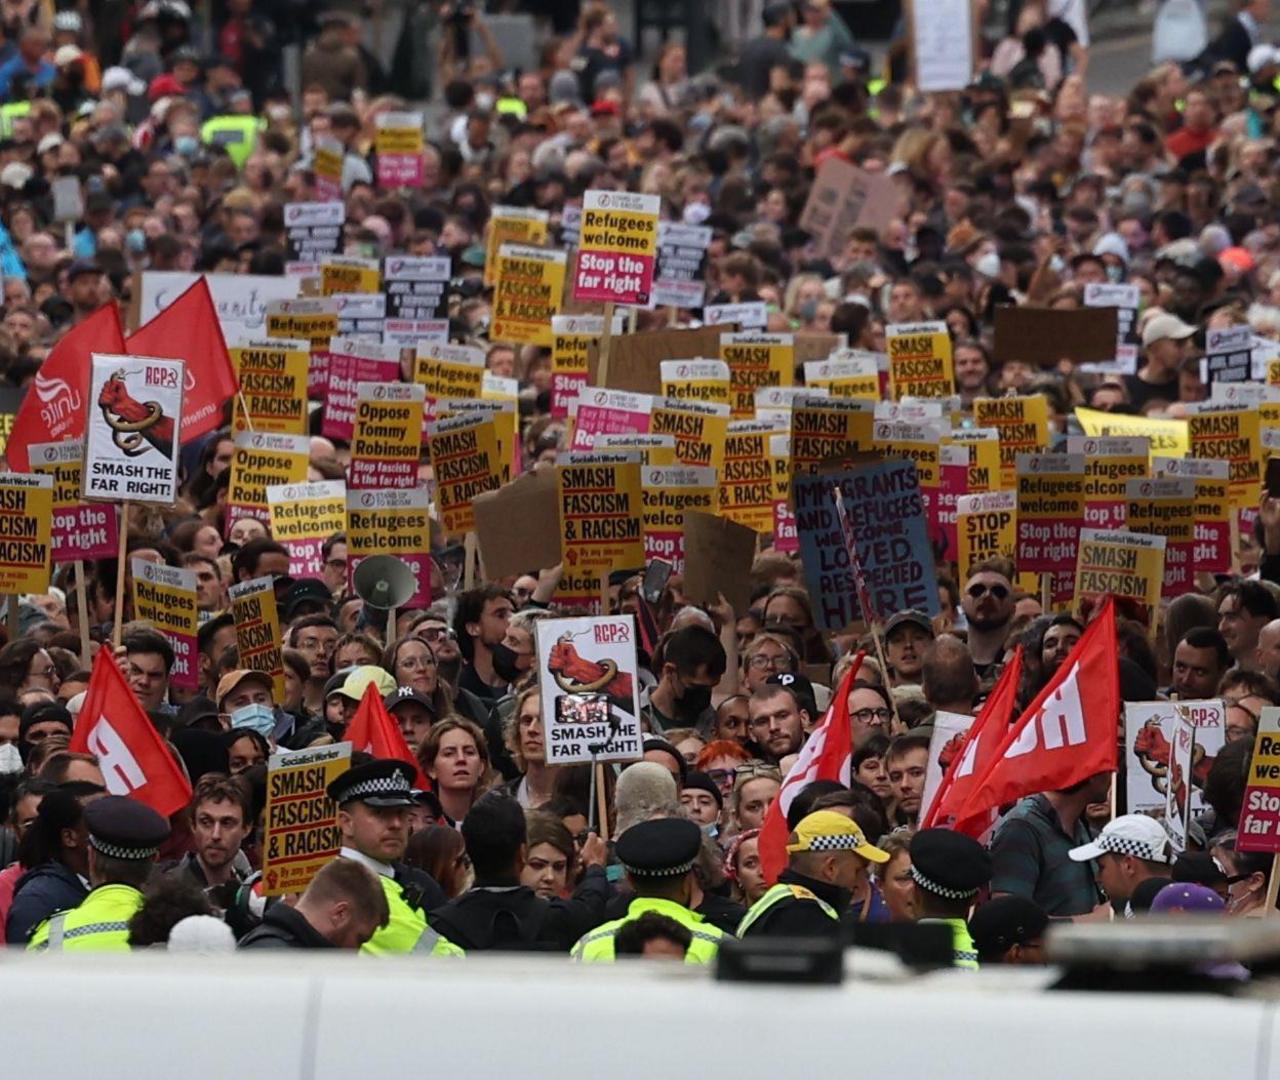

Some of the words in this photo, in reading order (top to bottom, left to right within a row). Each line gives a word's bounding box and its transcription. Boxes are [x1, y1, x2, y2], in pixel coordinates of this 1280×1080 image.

[585, 212, 653, 232] Refugees
[584, 232, 649, 249] welcome
[580, 254, 616, 274] Stop
[619, 257, 644, 274] the
[578, 272, 600, 289] far
[604, 277, 641, 294] right
[240, 352, 286, 369] SMASH
[145, 367, 167, 385] RCP
[359, 403, 410, 420] Oppose
[359, 422, 406, 441] Tommy
[356, 441, 417, 457] Robinson
[432, 430, 477, 456] SMASH
[237, 451, 292, 469] Oppose
[354, 460, 376, 473] Stop
[378, 462, 410, 473] fascists
[436, 452, 489, 482] FASCISM
[92, 463, 145, 477] SMASH
[146, 466, 172, 480] THE
[562, 467, 615, 488] SMASH
[91, 479, 119, 491] FAR
[126, 482, 170, 496] RIGHT!
[1021, 479, 1082, 495] Refugees
[274, 502, 344, 519] Refugees
[563, 492, 629, 513] FASCISM
[1020, 500, 1079, 513] welcome
[276, 518, 343, 536] welcome
[350, 512, 425, 531] Refugees
[565, 521, 577, 539] &
[581, 519, 640, 539] RACISM
[967, 512, 1011, 532] STOP
[70, 528, 107, 549] right
[351, 533, 422, 548] welcome
[1020, 524, 1050, 540] Stop
[1053, 524, 1077, 538] the
[968, 533, 999, 551] THE
[1020, 544, 1040, 559] far
[1044, 544, 1076, 561] right
[137, 582, 194, 610] Refugees
[139, 606, 191, 629] welcome
[594, 624, 616, 642] RCP
[552, 744, 581, 756] FAR
[271, 767, 326, 798] SMASH
[271, 797, 336, 828] FASCISM
[1243, 815, 1272, 834] far
